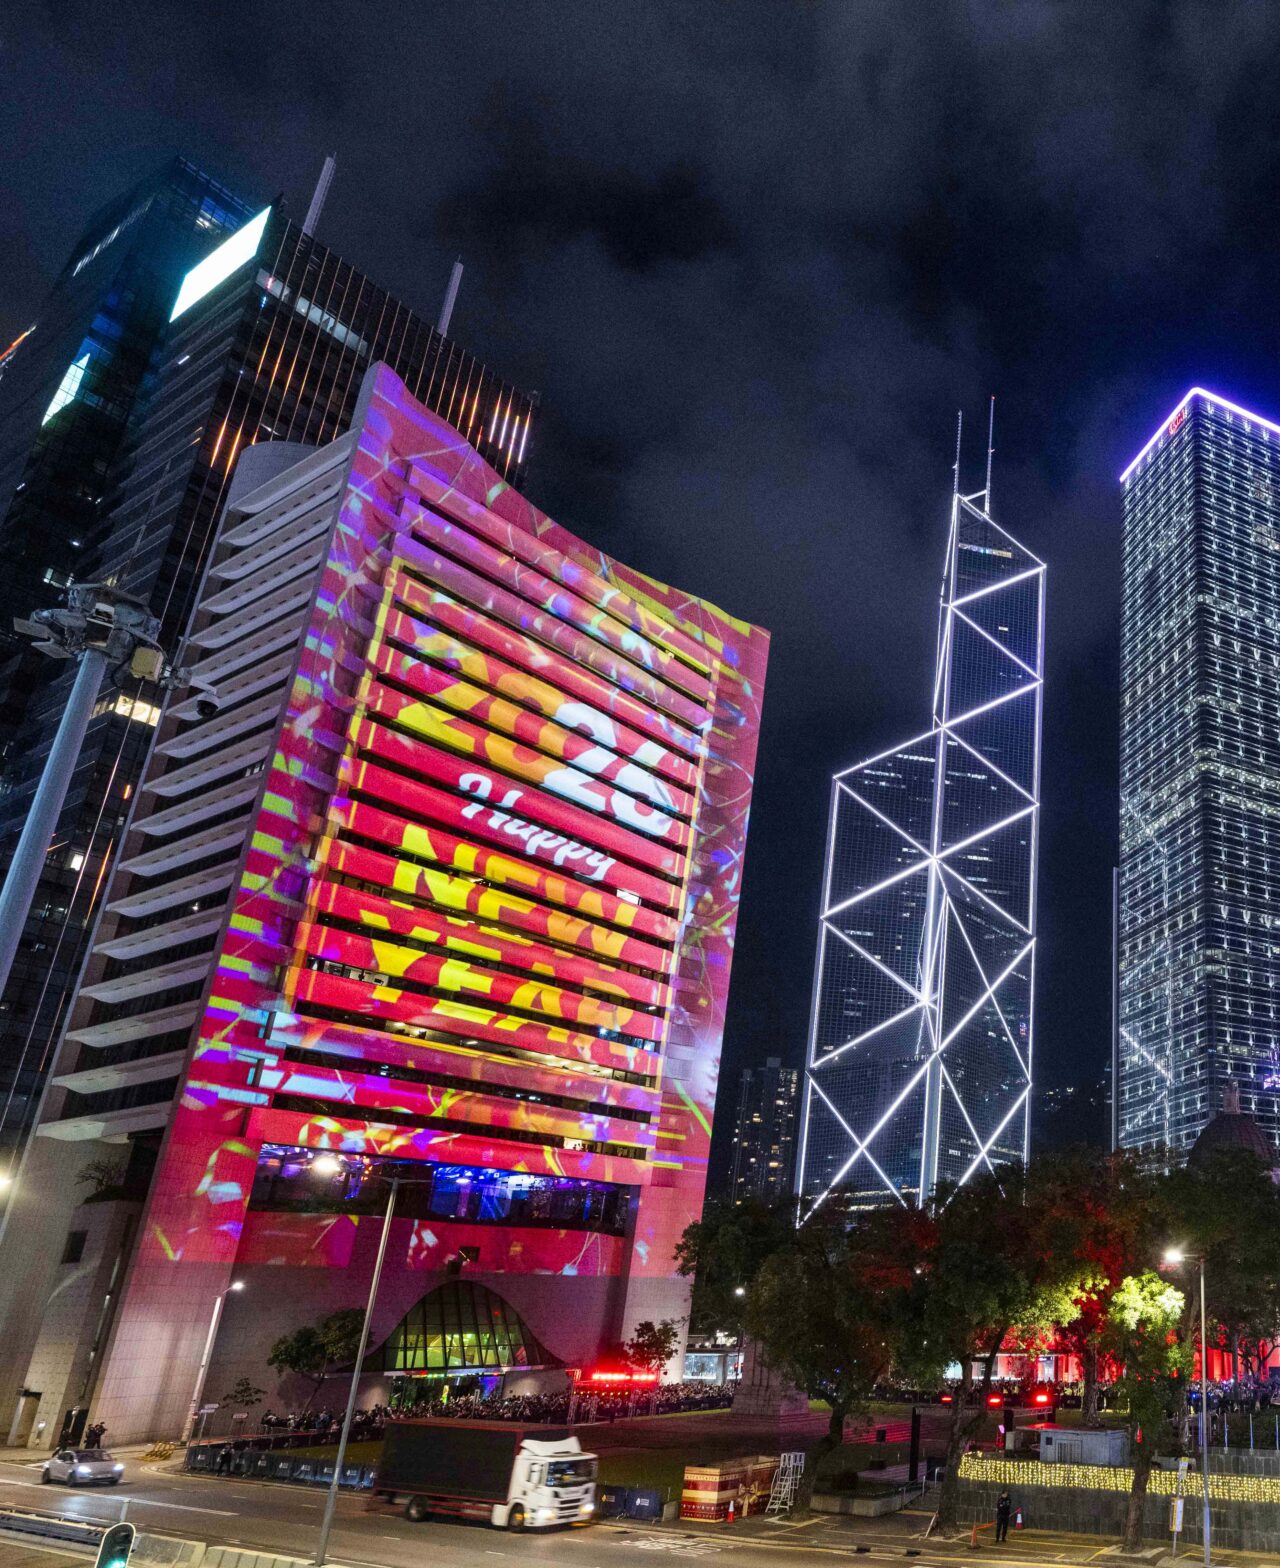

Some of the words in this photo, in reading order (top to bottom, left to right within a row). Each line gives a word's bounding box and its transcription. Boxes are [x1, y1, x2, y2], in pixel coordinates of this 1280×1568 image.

[397, 630, 678, 837] 2026
[390, 823, 639, 972] NEW
[458, 773, 616, 881] Happy
[359, 908, 639, 1056] YEAR
